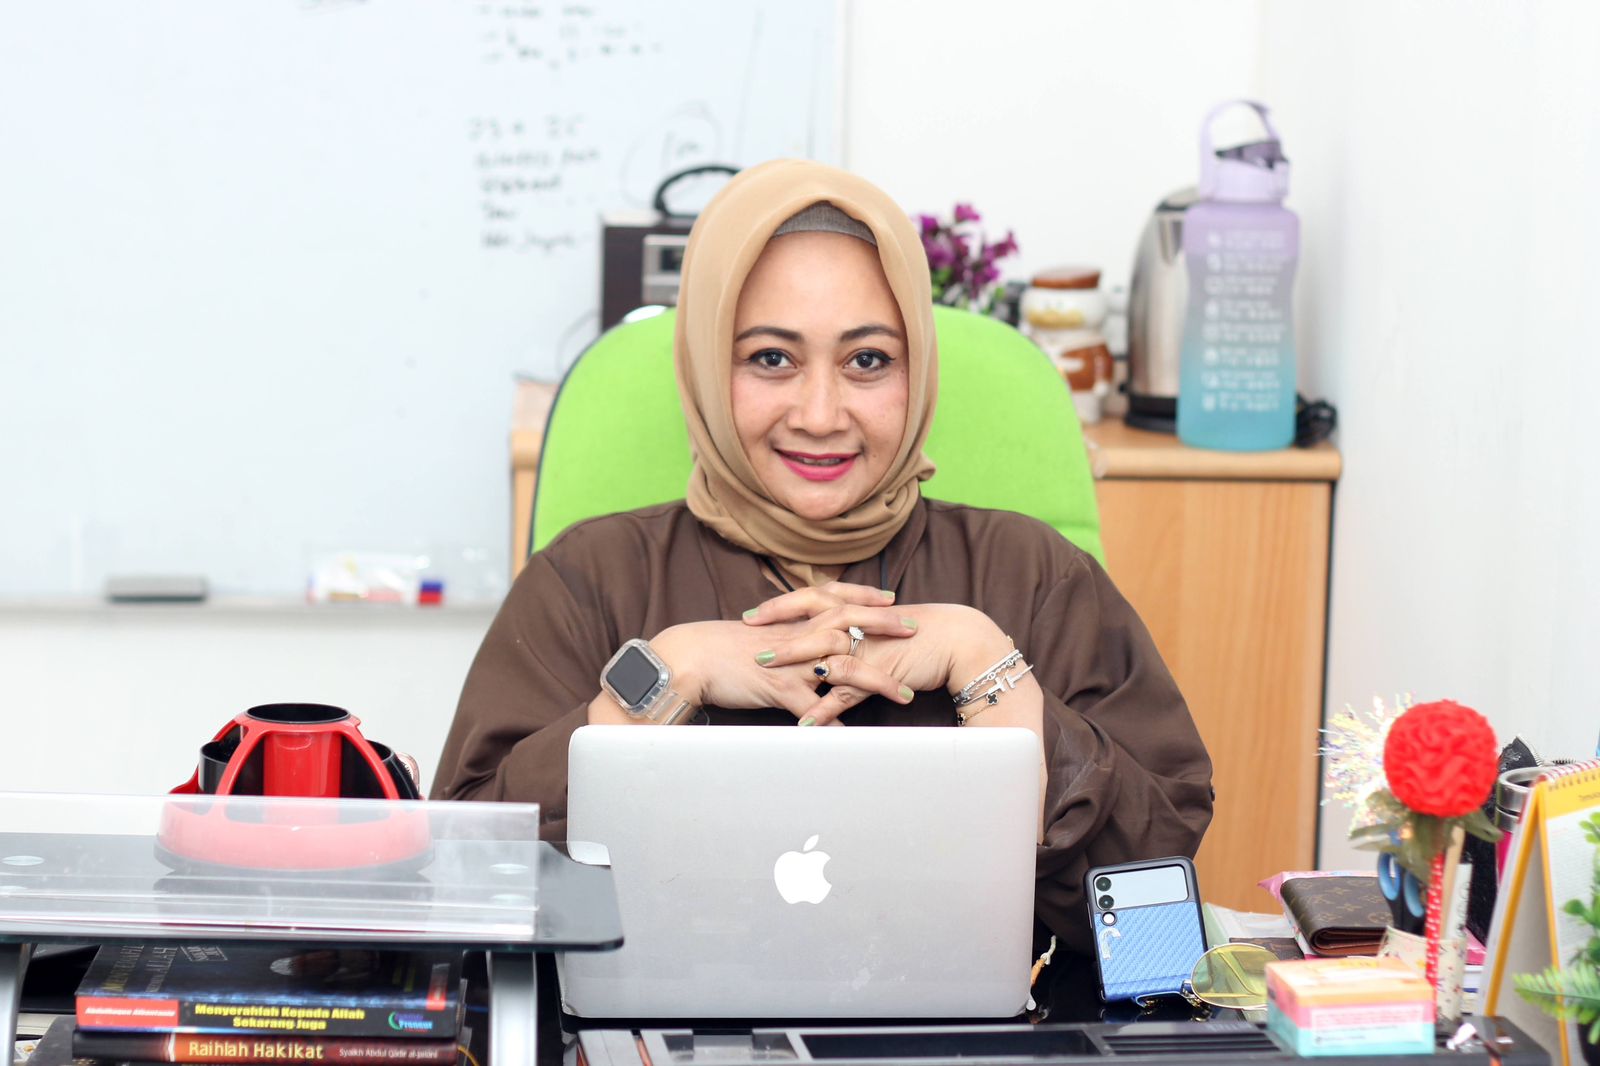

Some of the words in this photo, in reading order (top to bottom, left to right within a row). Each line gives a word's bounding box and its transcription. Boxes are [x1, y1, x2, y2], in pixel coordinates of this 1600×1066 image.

[195, 1004, 280, 1016] Menyerahlah
[281, 1007, 330, 1018] Kepada
[331, 1008, 365, 1020] Allah
[233, 1017, 295, 1030] Sekarang
[296, 1019, 327, 1031] Juga
[189, 1041, 249, 1057] Raihlah
[253, 1043, 323, 1060] Hakikat
